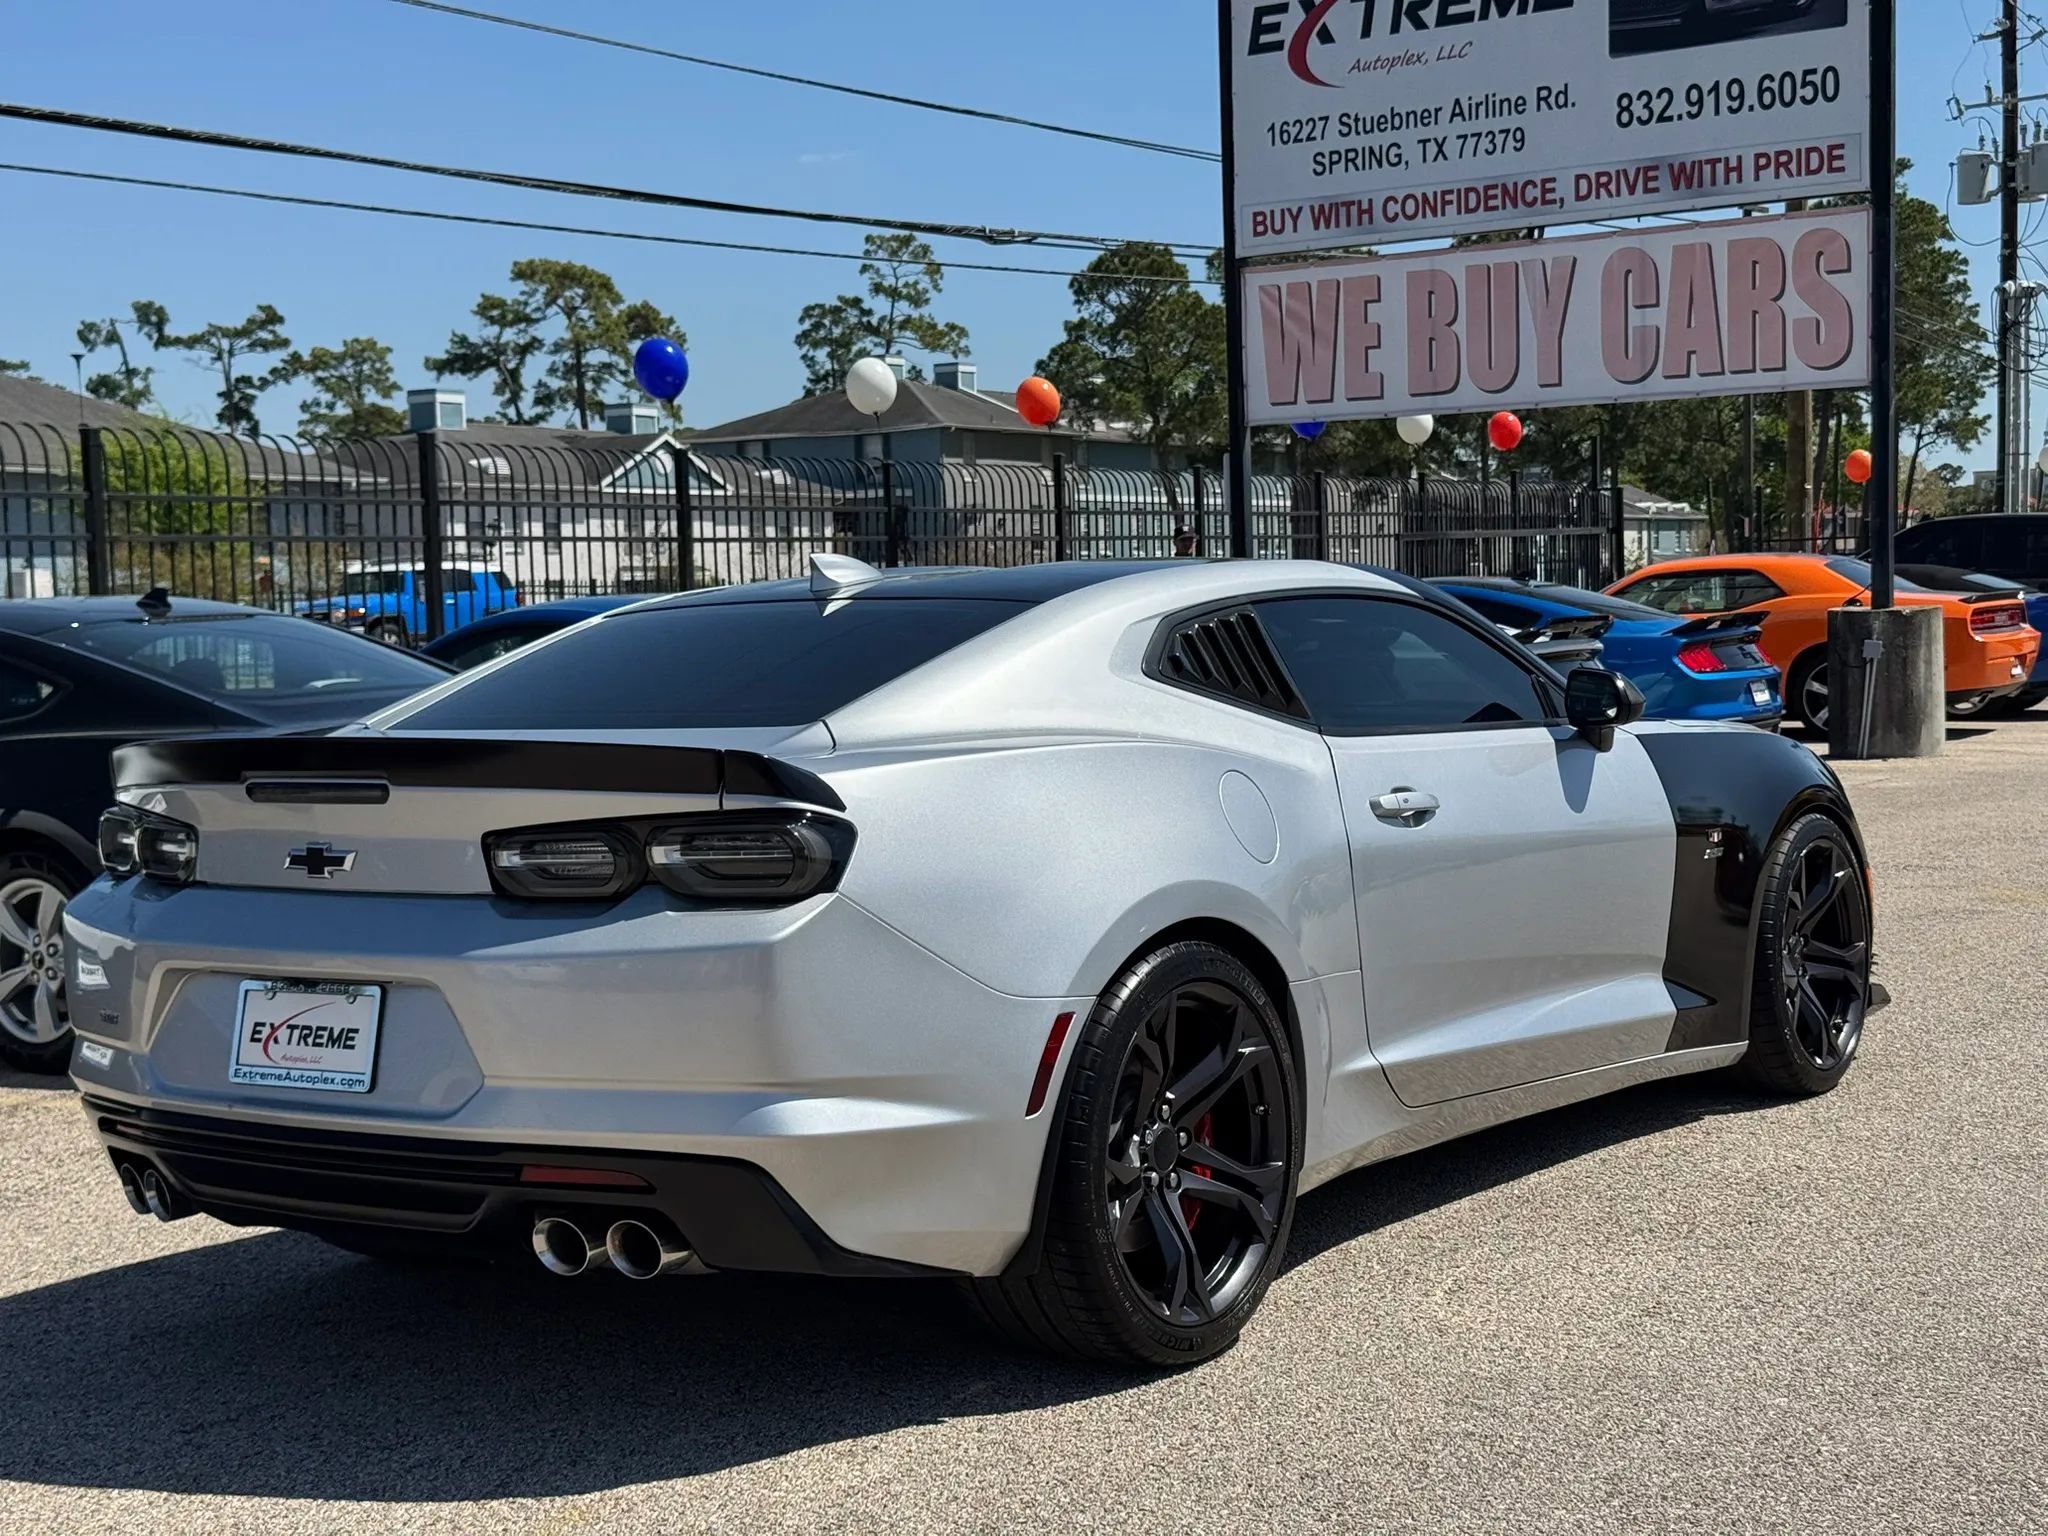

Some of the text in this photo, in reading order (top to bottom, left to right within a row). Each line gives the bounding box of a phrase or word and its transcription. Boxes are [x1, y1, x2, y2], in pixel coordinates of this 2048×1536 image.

[1347, 41, 1473, 75] Autoplex, LLC
[1267, 83, 1576, 146] 16227 Stuebner Airline Rd.
[1616, 65, 1841, 129] 832.919.6050
[1312, 127, 1525, 176] SPRING, TX 77379
[1251, 142, 1846, 238] BUY WITH CONFIDENCE, DRIVE WITH PRIDE
[1258, 227, 1853, 406] WE BUY CARS
[250, 1021, 360, 1050] EXTREME
[233, 1067, 366, 1088] ExtremeAutoplex.com
